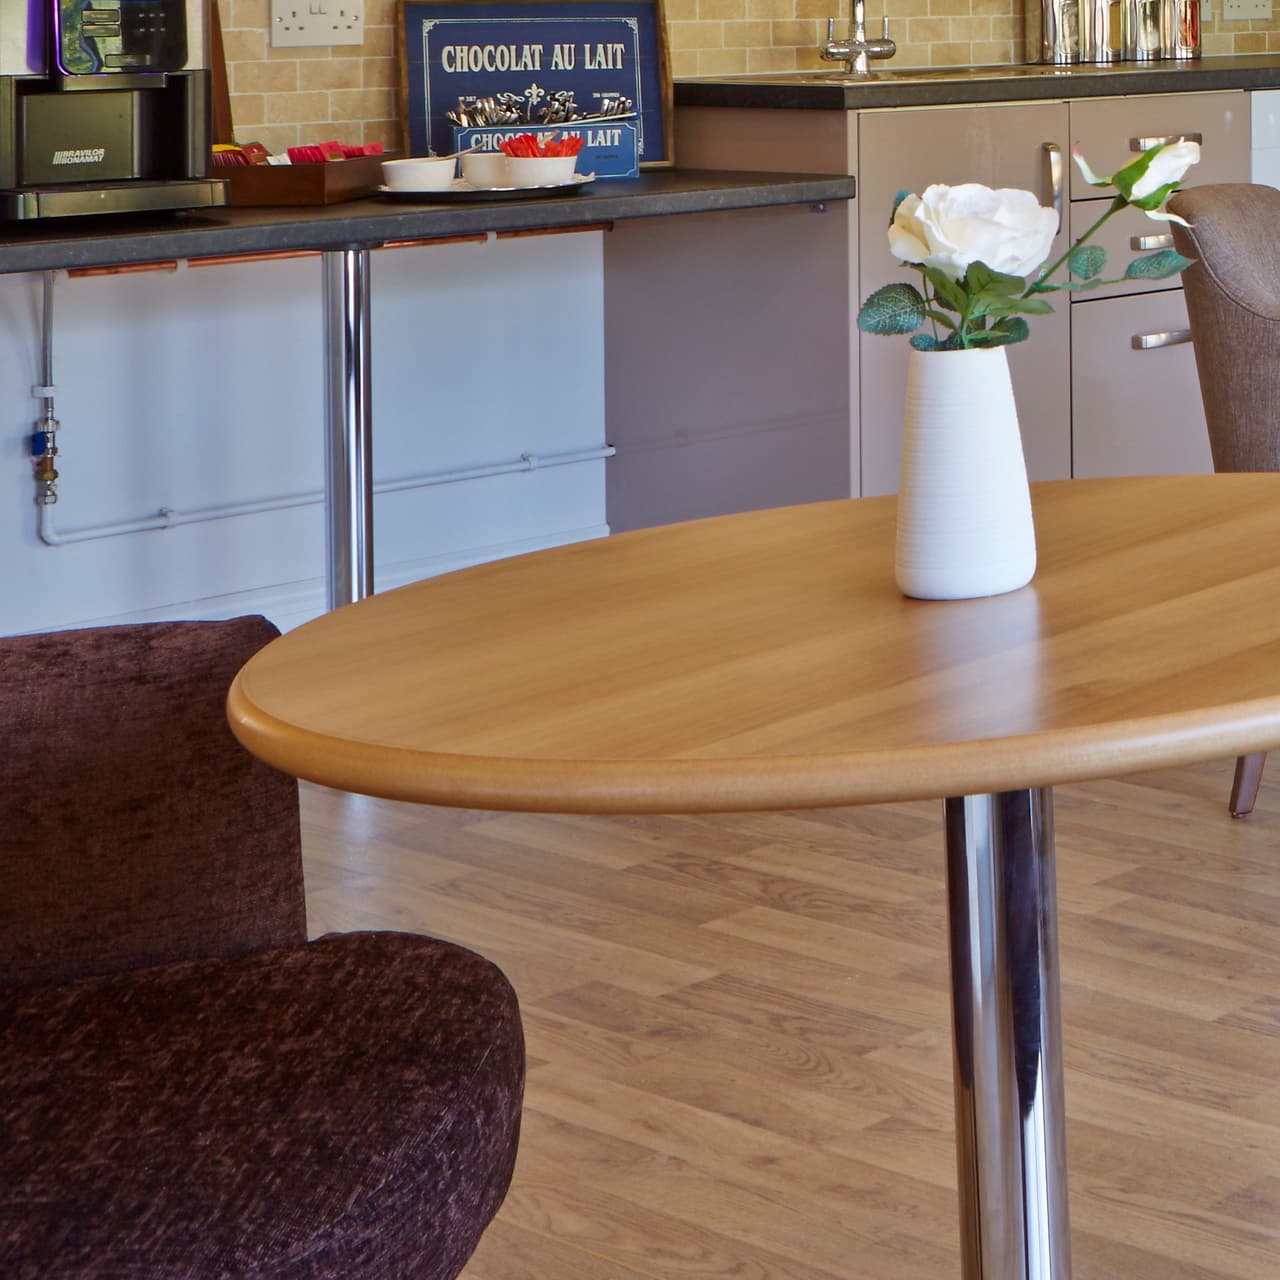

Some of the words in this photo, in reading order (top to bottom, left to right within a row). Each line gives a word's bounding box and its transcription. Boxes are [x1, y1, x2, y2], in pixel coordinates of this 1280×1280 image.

[441, 44, 543, 73] CHOCOLAT
[551, 44, 576, 70] AU
[584, 43, 625, 70] LAIT
[586, 129, 622, 147] LAIT
